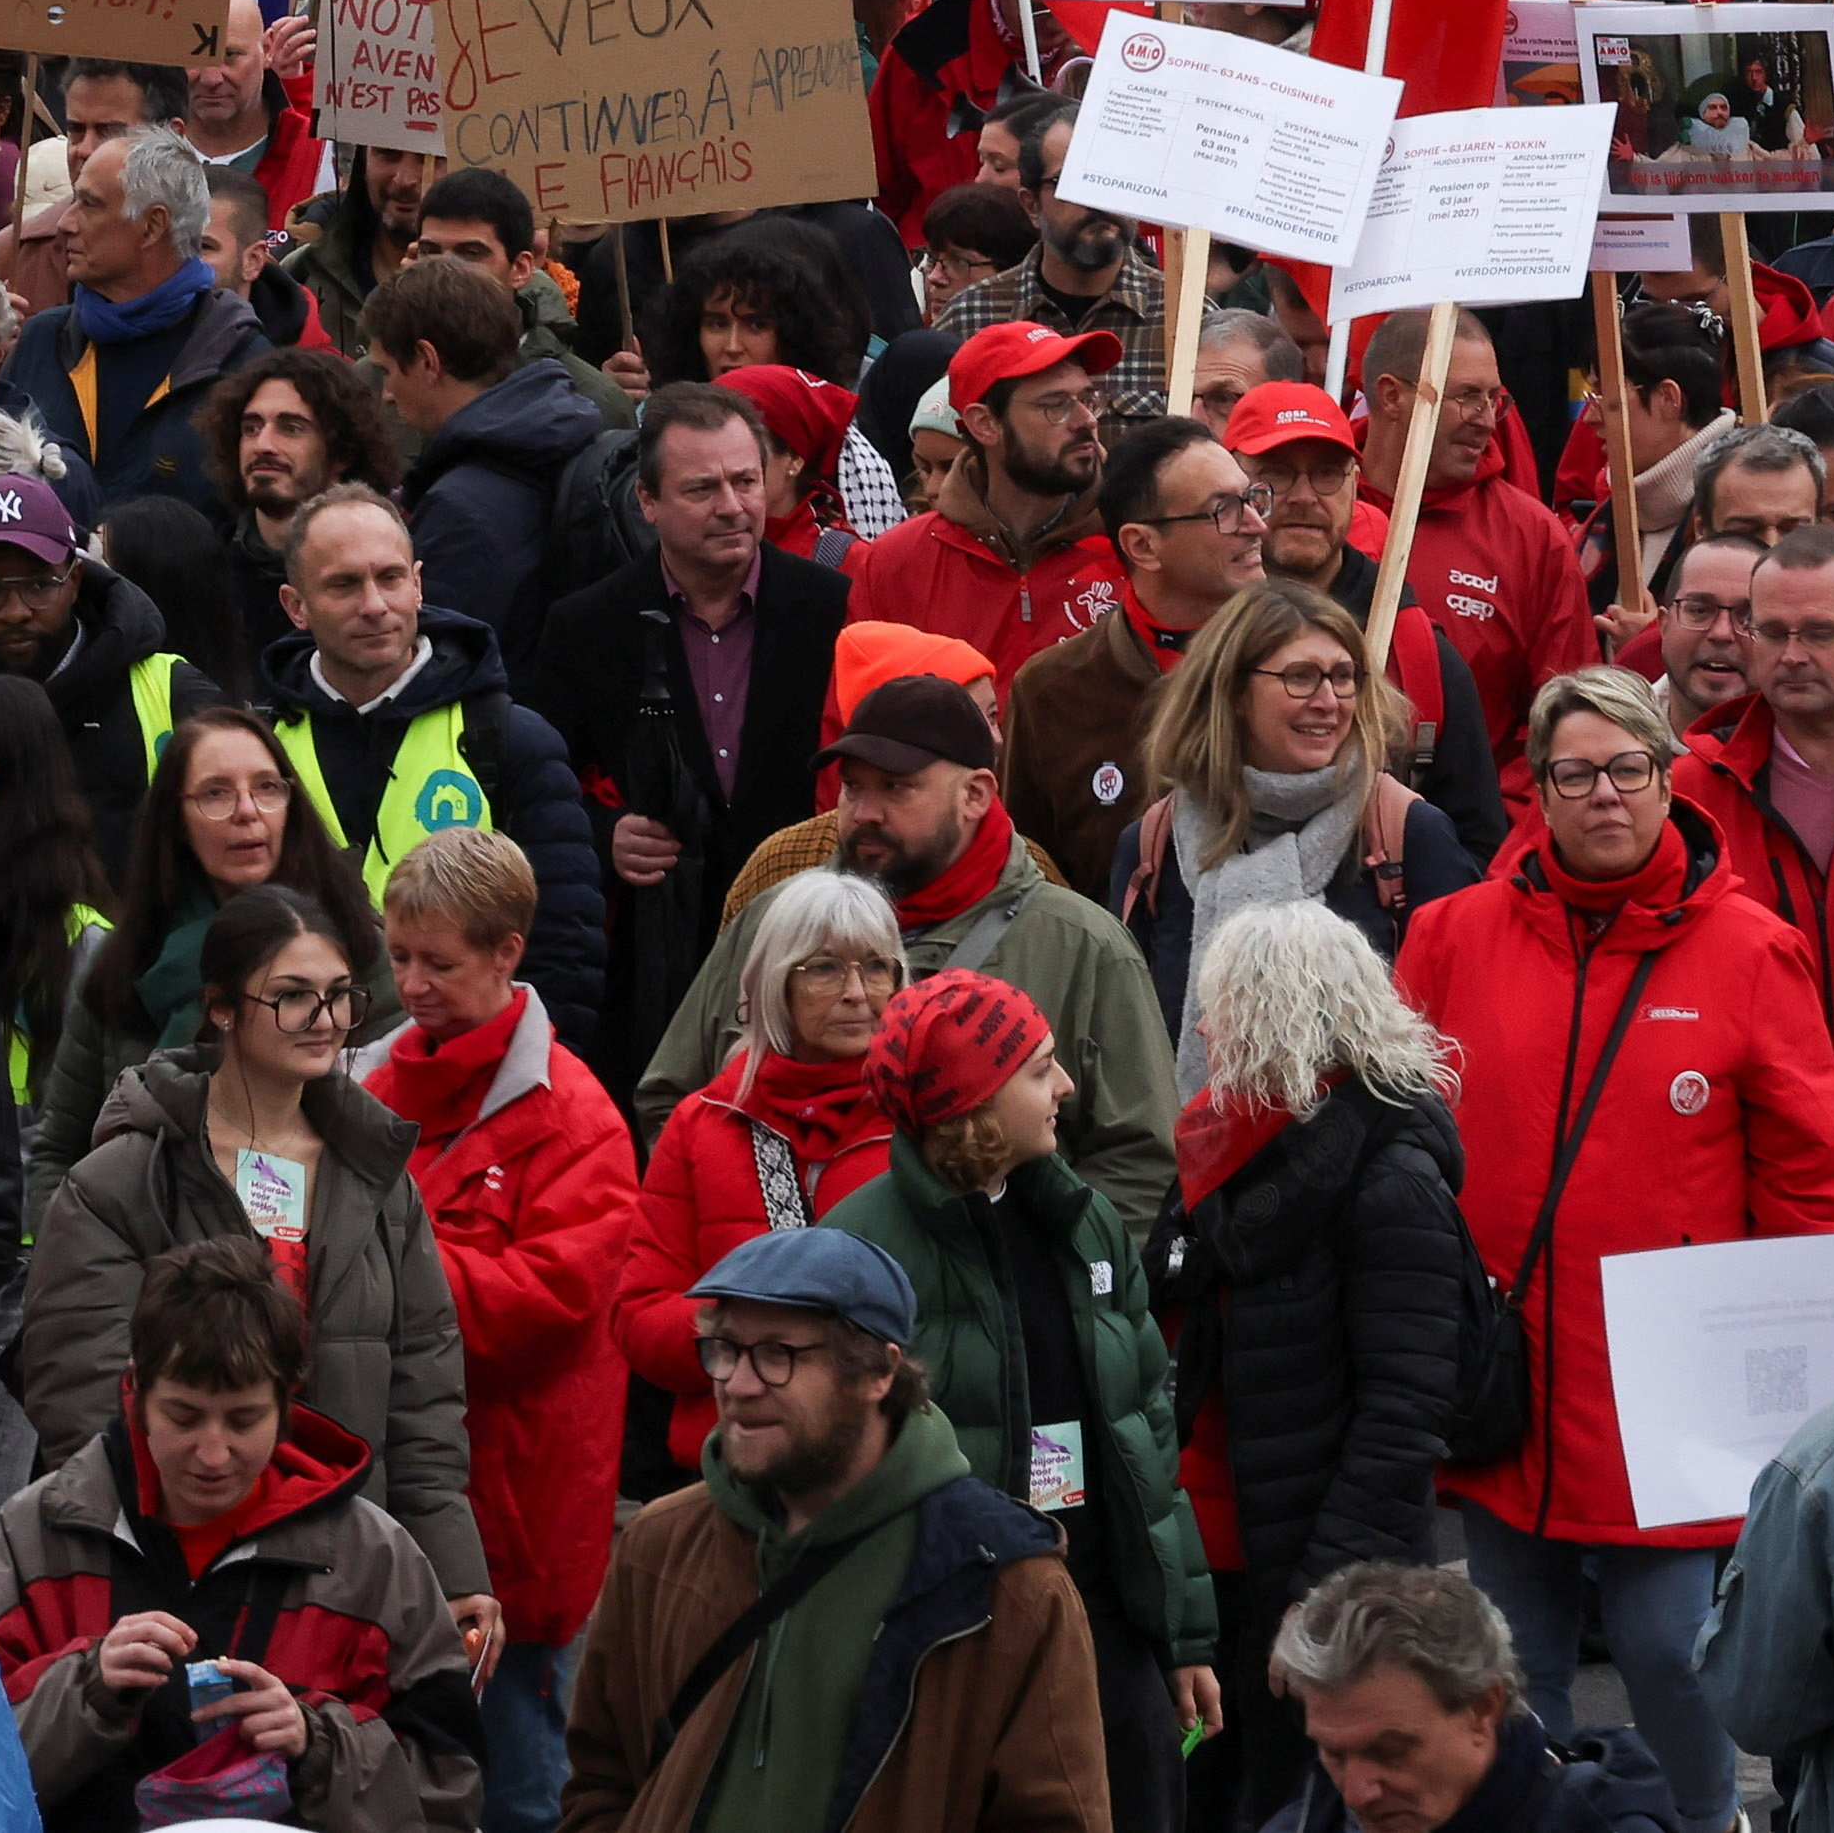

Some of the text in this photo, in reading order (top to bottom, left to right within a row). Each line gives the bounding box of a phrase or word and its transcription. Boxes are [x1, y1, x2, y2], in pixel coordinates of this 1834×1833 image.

[1126, 43, 1336, 109] AMiO SOPHIE 63 ANS CUISINIÈRE
[325, 76, 441, 117] N'EST PAS
[1127, 83, 1169, 98] CARRIÈRE
[1194, 97, 1231, 111] SYSTEME
[1233, 104, 1266, 121] ACTUEL
[1320, 130, 1360, 149] ARIZONA
[1195, 122, 1250, 145] Pension à
[1201, 138, 1237, 156] 63 ans
[1403, 139, 1547, 160] SOPHIE 63 JAREN KOKKIN
[1193, 149, 1239, 168] (Mai 2027)
[1433, 152, 1586, 167] HUIDIG SYSTEEM ARIZONA-SYSTEEM
[1651, 168, 1820, 187] is tijd om wakker worden
[1429, 180, 1490, 195] Pensioen op
[1081, 171, 1340, 245] #STOPARIZONA #PENSIONDEMERDE
[1439, 195, 1473, 208] 63 jaar
[1427, 208, 1480, 222] (mei 2027)
[1343, 264, 1572, 293] #STOPARIZONA #VERDOMDPENSIOEN
[1449, 569, 1498, 594] acod
[250, 1180, 292, 1199] Miljarden
[250, 1192, 271, 1203] voor
